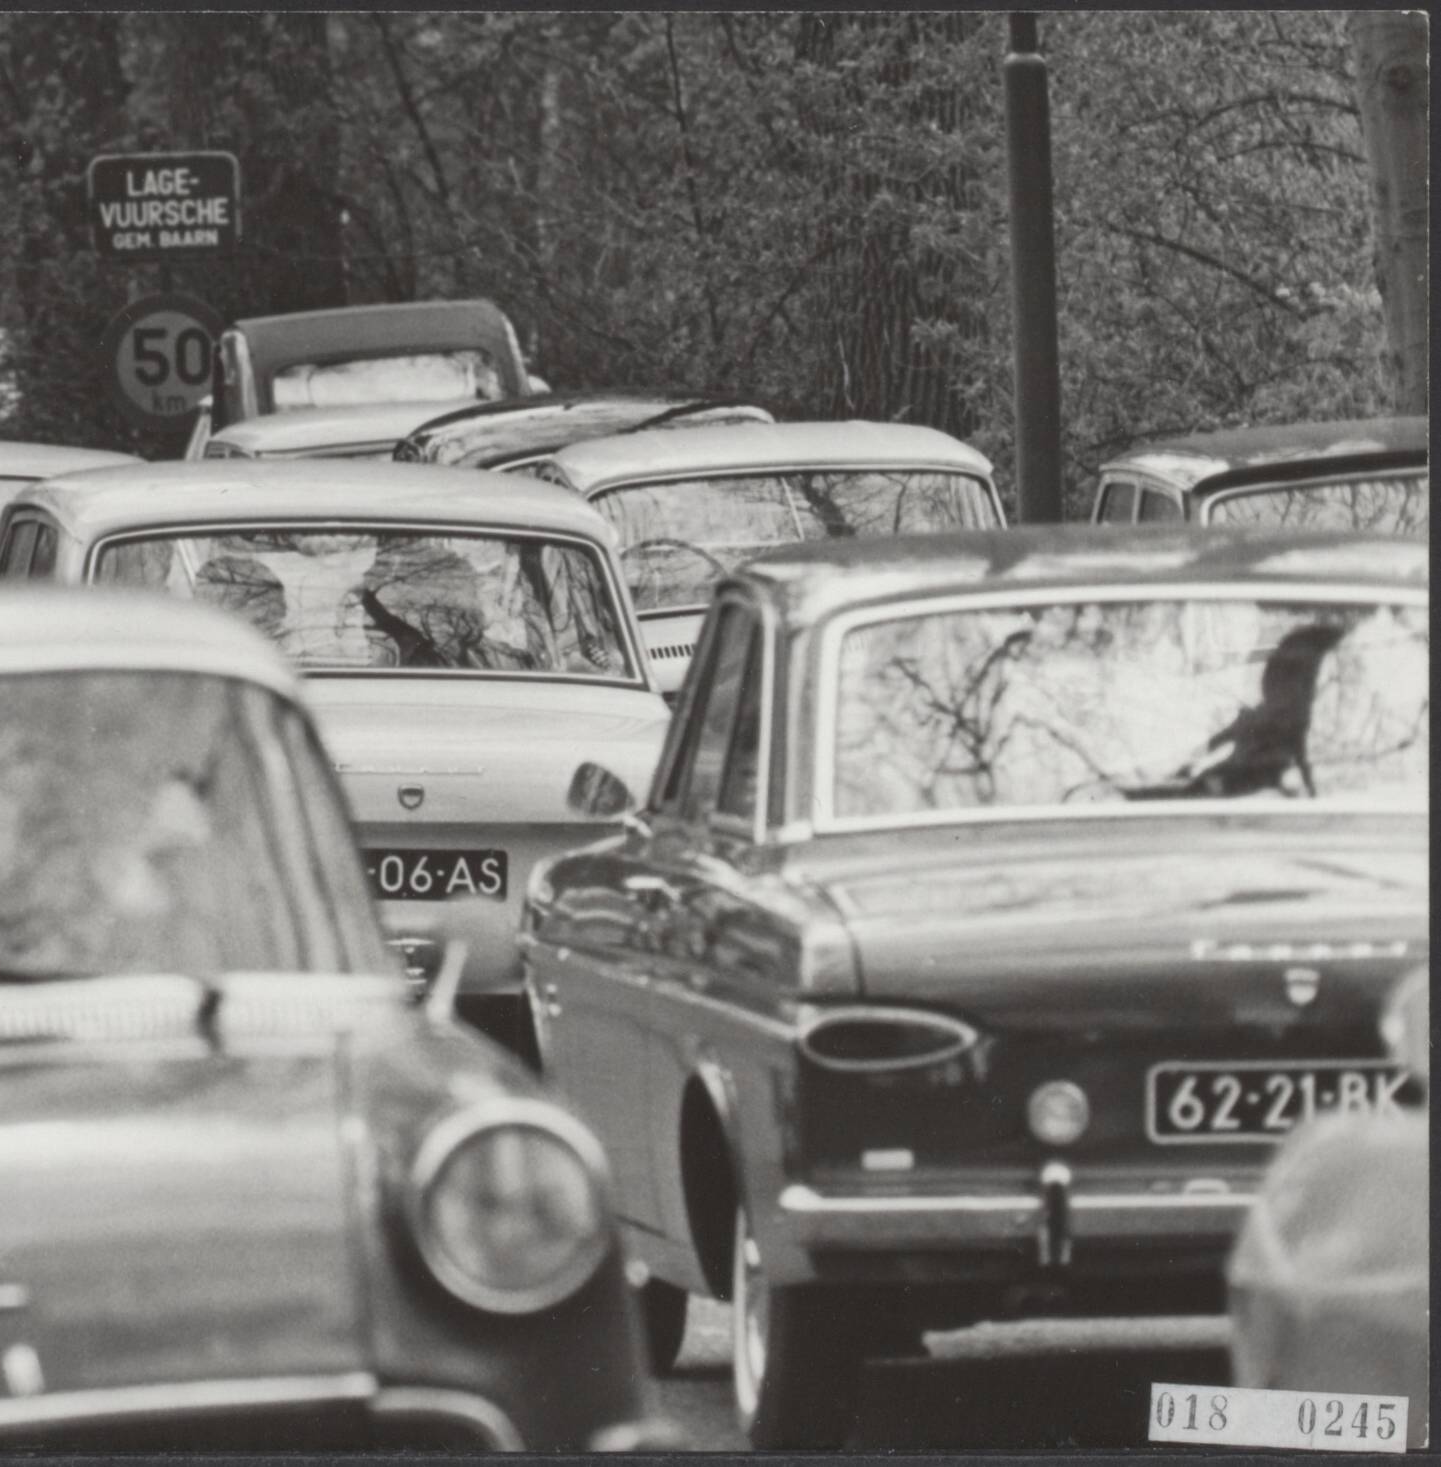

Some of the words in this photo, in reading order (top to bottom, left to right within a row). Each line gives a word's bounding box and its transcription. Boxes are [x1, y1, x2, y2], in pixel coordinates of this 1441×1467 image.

[126, 168, 200, 196] LAGE-
[101, 198, 229, 228] VUURSCHE
[160, 230, 218, 247] BAARN
[133, 328, 210, 386] 50
[153, 388, 186, 411] km
[367, 855, 502, 894] -06-AS
